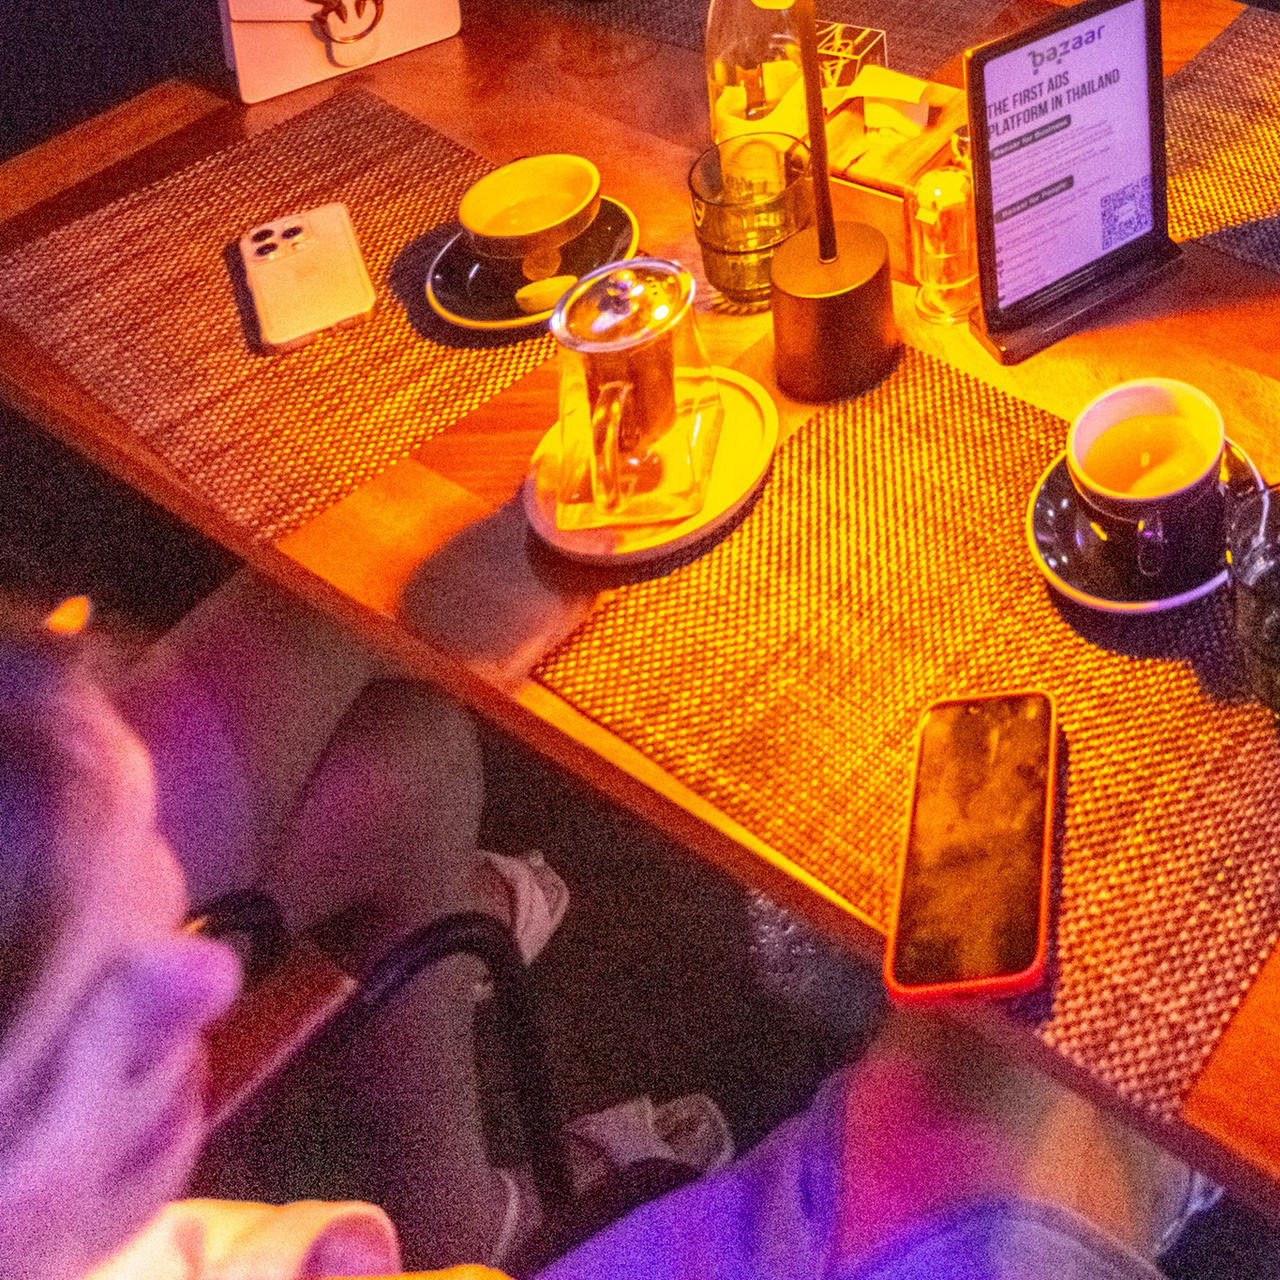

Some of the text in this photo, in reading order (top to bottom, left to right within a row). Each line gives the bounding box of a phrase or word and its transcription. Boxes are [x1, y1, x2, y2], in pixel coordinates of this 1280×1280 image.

[1027, 25, 1106, 75] bazaar
[987, 70, 1070, 120] THE FIRST ADS
[987, 68, 1120, 137] PLATFORM IN THAILAND
